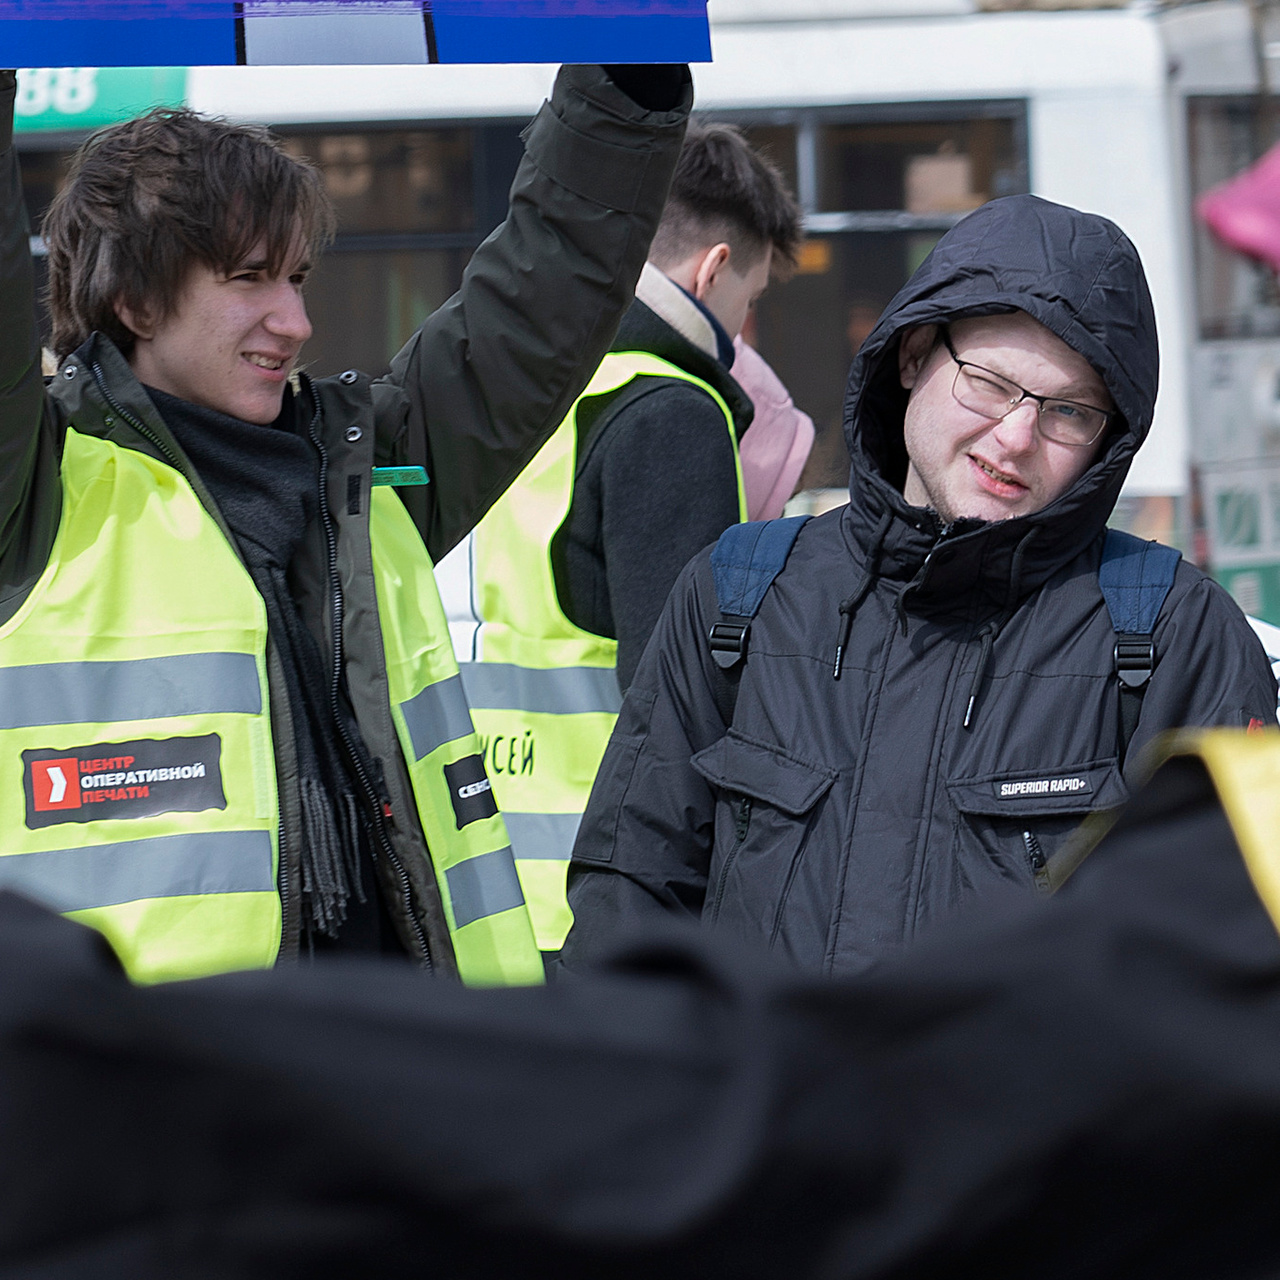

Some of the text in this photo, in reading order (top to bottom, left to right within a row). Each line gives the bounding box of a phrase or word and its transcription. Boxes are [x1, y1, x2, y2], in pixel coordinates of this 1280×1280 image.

[79, 756, 135, 773] ЦЕНТР
[80, 762, 206, 789] ОПЕРАТИВНОЙ
[82, 786, 150, 804] ПЕЧАТИ
[1001, 780, 1049, 796] SUPERIOR
